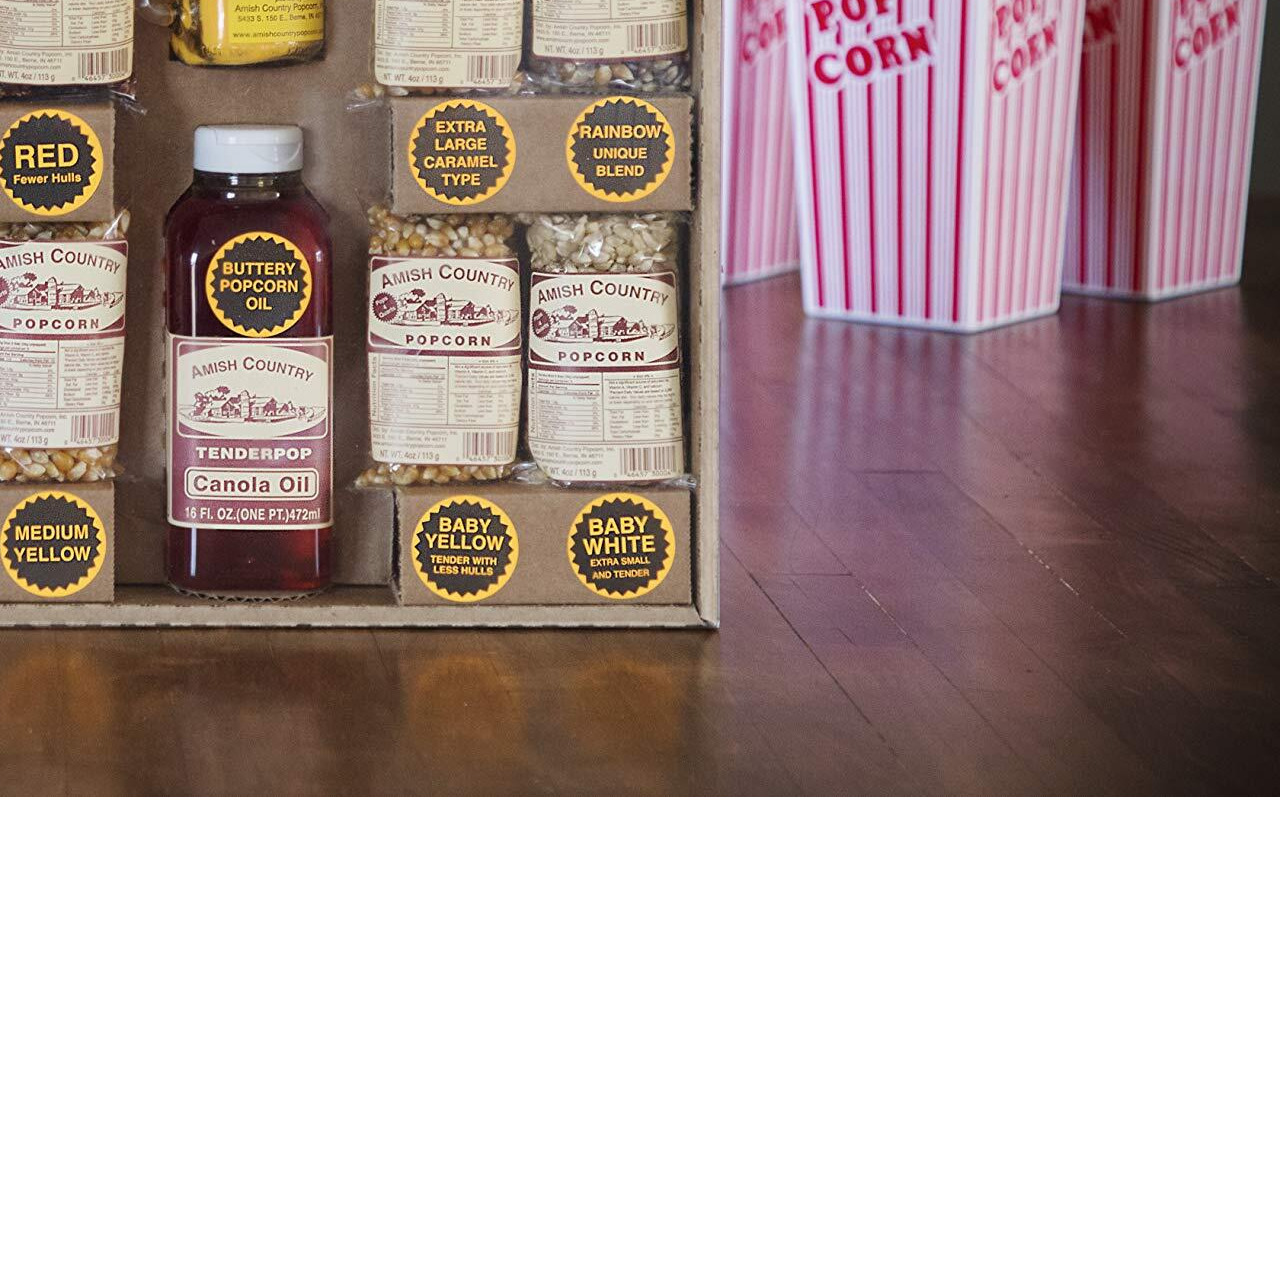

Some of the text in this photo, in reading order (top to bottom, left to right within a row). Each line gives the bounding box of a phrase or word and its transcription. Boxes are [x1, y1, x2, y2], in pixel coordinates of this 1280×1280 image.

[234, 4, 260, 12] Amish
[262, 4, 292, 12] Country
[1175, 0, 1239, 68] CORN
[586, 46, 598, 54] 113
[814, 25, 931, 84] CORN
[993, 18, 1057, 92] CORN
[8, 71, 19, 79] WT.
[436, 120, 486, 134] EXTRA
[579, 124, 662, 139] RAINBOW
[435, 138, 487, 151] LARGE
[14, 143, 80, 170] RED
[593, 147, 648, 160] UNIQUE
[424, 155, 498, 168] CARAMEL
[596, 164, 644, 176] BLEND
[13, 172, 82, 184] Fewer Hulls
[441, 173, 480, 186] TYPE
[51, 248, 120, 274] COUNTRY
[222, 262, 296, 276] BUTTERY
[382, 264, 514, 292] AMISH COUNTRY
[220, 279, 298, 292] POPCORN
[538, 280, 668, 306] AMISH COUNTRY
[246, 297, 272, 310] OIL
[13, 318, 99, 329] POPCORN
[406, 334, 491, 346] POPCORN
[558, 351, 645, 362] POPCORN
[192, 356, 314, 382] AMISH COUNTRY
[31, 436, 42, 444] 113
[196, 447, 312, 460] TENDERPOP
[422, 452, 434, 460] 113
[580, 468, 590, 476] 113
[193, 475, 309, 493] Canola Oil
[185, 506, 196, 519] 16
[15, 524, 89, 540] MEDIUM
[439, 517, 491, 534] BABY
[589, 516, 649, 536] BABY
[425, 534, 504, 551] YELLOW
[582, 534, 656, 555] WHITE
[14, 546, 90, 562] YELLOW
[430, 554, 498, 566] TENDER WITH
[590, 556, 650, 567] EXTRA SMALL
[434, 566, 494, 576] LESS HULLS
[592, 568, 650, 580] AND TENDER
